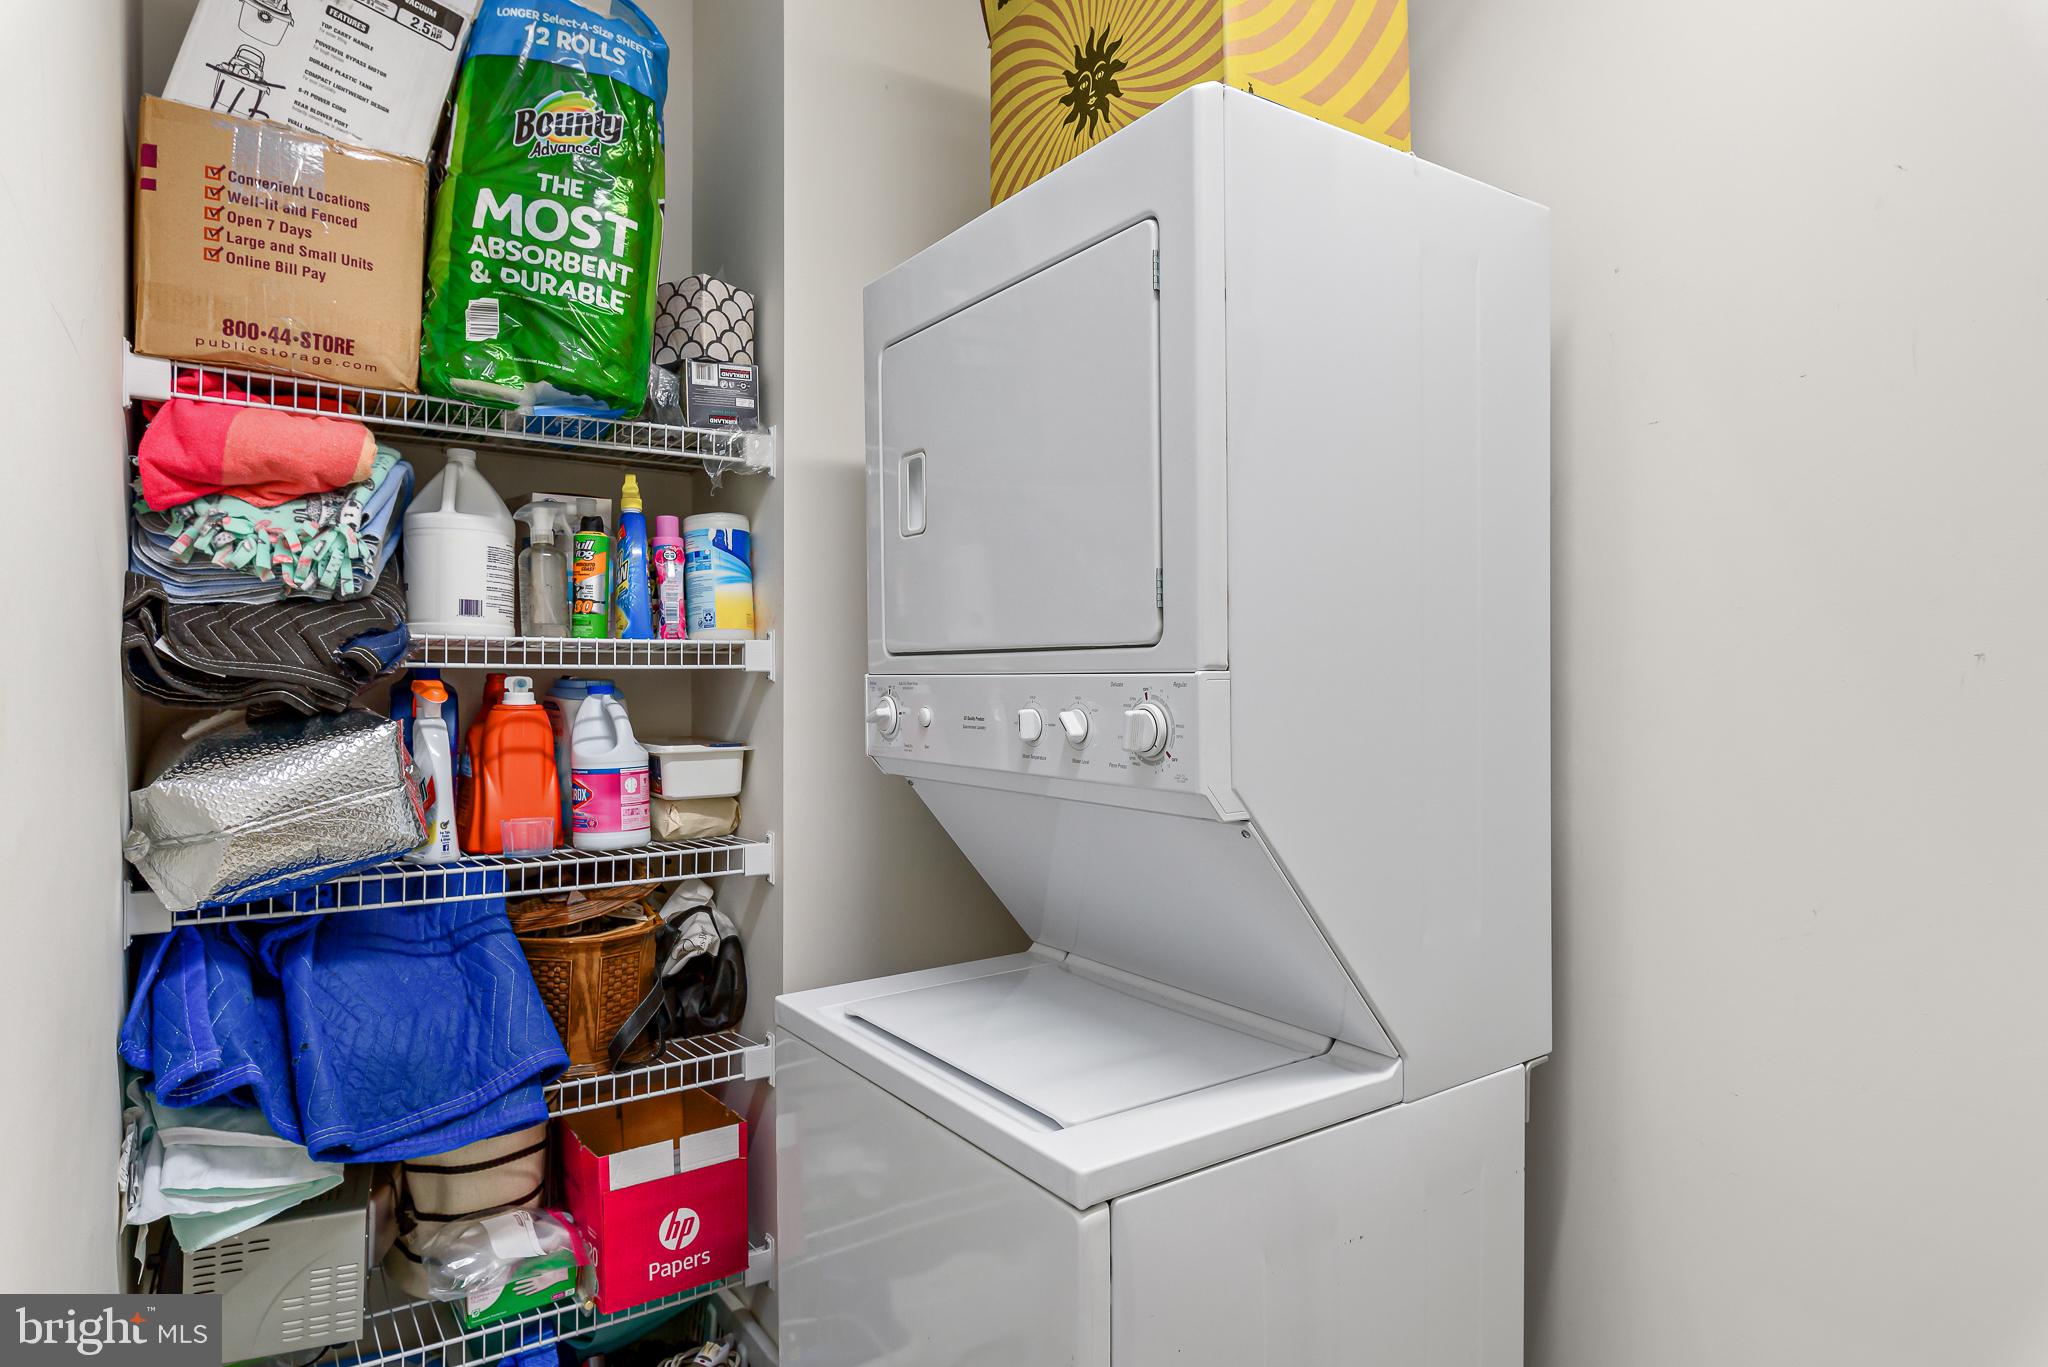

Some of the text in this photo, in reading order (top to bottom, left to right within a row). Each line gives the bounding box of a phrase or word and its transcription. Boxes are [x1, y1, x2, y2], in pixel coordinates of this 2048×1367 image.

[329, 8, 366, 32] FEATURES
[410, 16, 431, 35] 2.5
[430, 31, 442, 39] HP
[496, 7, 654, 59] LONGER Select-A-Size SHEETS
[321, 21, 332, 30] TOP
[333, 28, 352, 40] CARRY
[353, 37, 374, 52] HANDLE
[524, 22, 627, 66] 12 ROLLS
[309, 56, 334, 72] DURABLE
[335, 69, 358, 84] PLASTIC
[359, 80, 373, 91] TANK
[315, 39, 344, 57] POWERFUL
[346, 54, 367, 68] BYPASS
[368, 64, 387, 78] MOTOR
[304, 69, 332, 86] COMPACT
[333, 82, 369, 104] LIGHTWEIGHT
[370, 100, 390, 114] DESIGN
[310, 92, 331, 105] POWER
[332, 102, 347, 114] CORD
[293, 100, 349, 129] REAR BLOWER PORT
[513, 108, 624, 146] Bounty
[528, 141, 602, 158] Advanced
[228, 170, 370, 213] Convenient Locations
[536, 172, 585, 199] THE
[227, 190, 358, 229] Well-lit and Fenced
[227, 211, 313, 239] Open 7 Days
[472, 187, 639, 258] MOST
[226, 230, 374, 272] Large and Small Units
[226, 251, 327, 283] Online Bill Pay
[467, 234, 634, 287] ABSORBENT
[469, 260, 492, 284] &
[195, 337, 378, 373] publicstorage.com
[576, 540, 595, 550] ull
[574, 600, 594, 614] 30
[664, 1210, 696, 1250] hp
[648, 1250, 711, 1281] Papers
